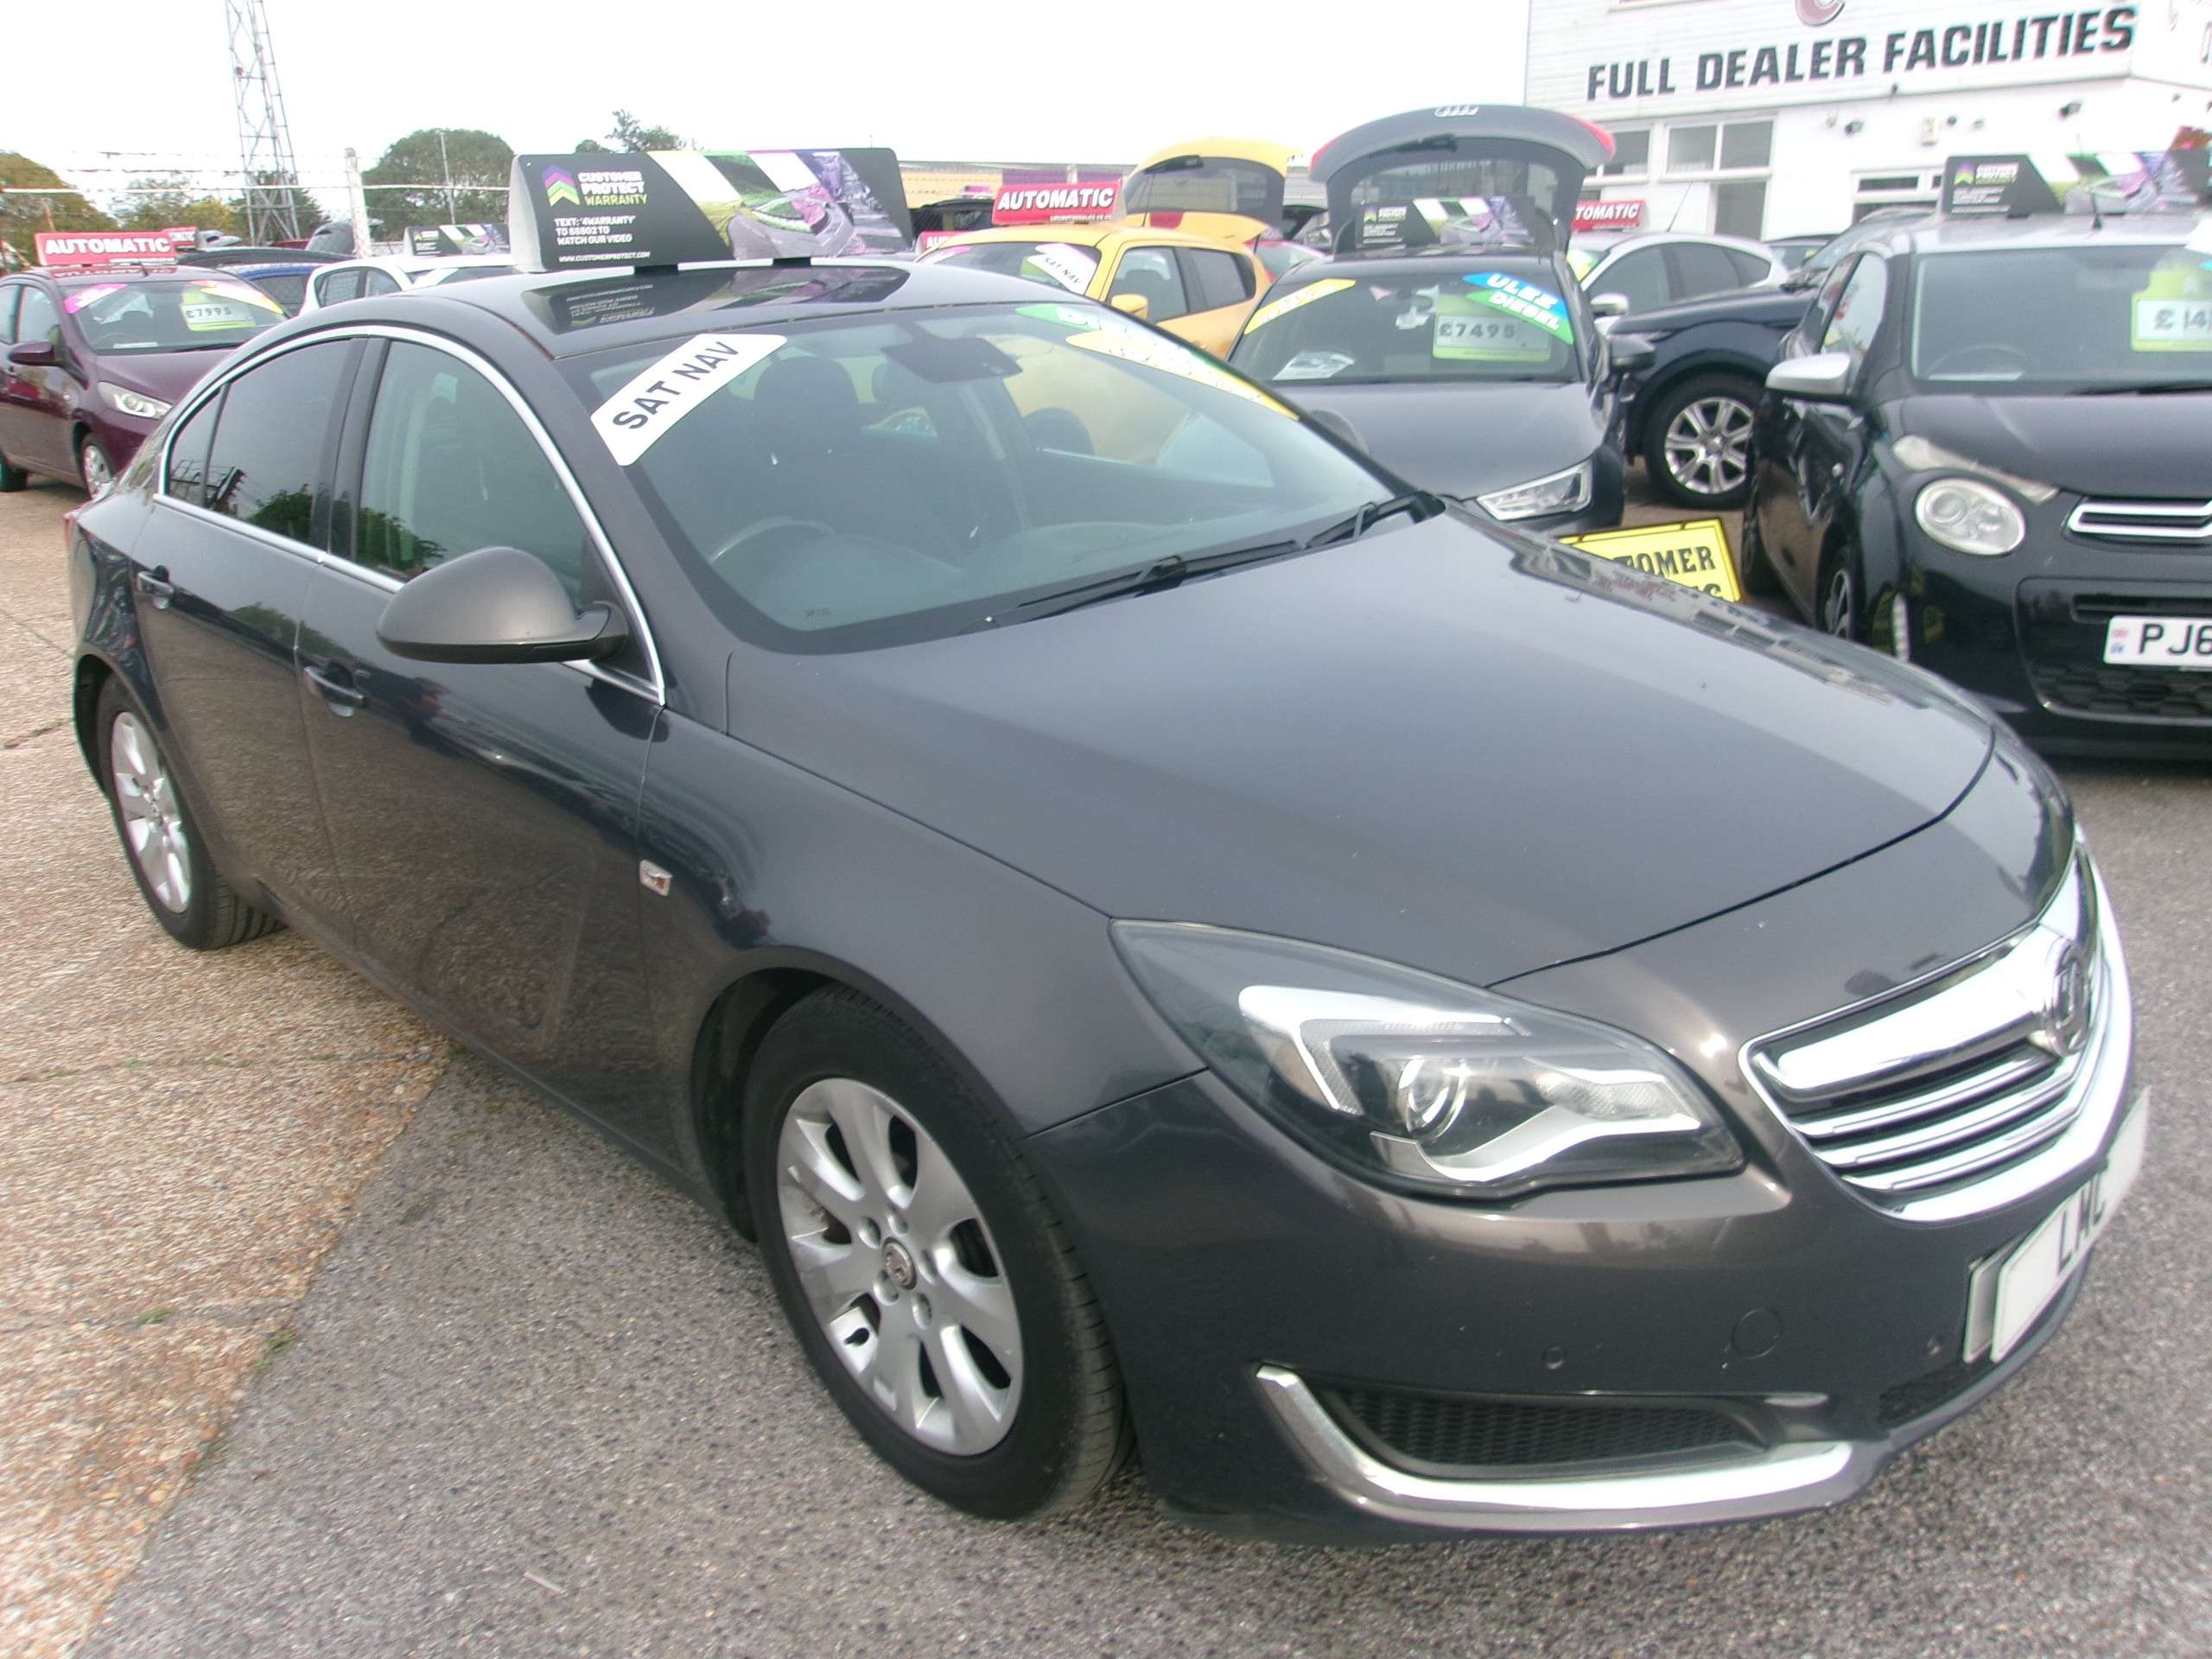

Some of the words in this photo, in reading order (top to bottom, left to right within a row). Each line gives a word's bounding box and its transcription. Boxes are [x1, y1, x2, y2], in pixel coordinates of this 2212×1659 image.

[1586, 58, 1676, 102] FULL
[1695, 36, 1868, 92] DEALER
[1882, 6, 2138, 74] FACILITIES
[578, 171, 643, 182] CUSTOMER
[580, 181, 645, 194] PROTECT
[584, 194, 647, 206] WARRANTY
[996, 188, 1114, 211] AUTOMATIC
[556, 227, 568, 236] TO
[598, 226, 610, 234] TO
[556, 236, 588, 245] WATCH
[588, 235, 607, 245] OUR
[607, 233, 632, 243] VIDEO
[44, 238, 170, 254] AUTOMATIC
[1486, 273, 1559, 310] ULEZ
[1488, 291, 1560, 330] DIESEL
[2154, 308, 2212, 332] £14
[1438, 323, 1516, 339] £7495
[612, 380, 682, 429] SAT
[671, 340, 740, 381] NAV
